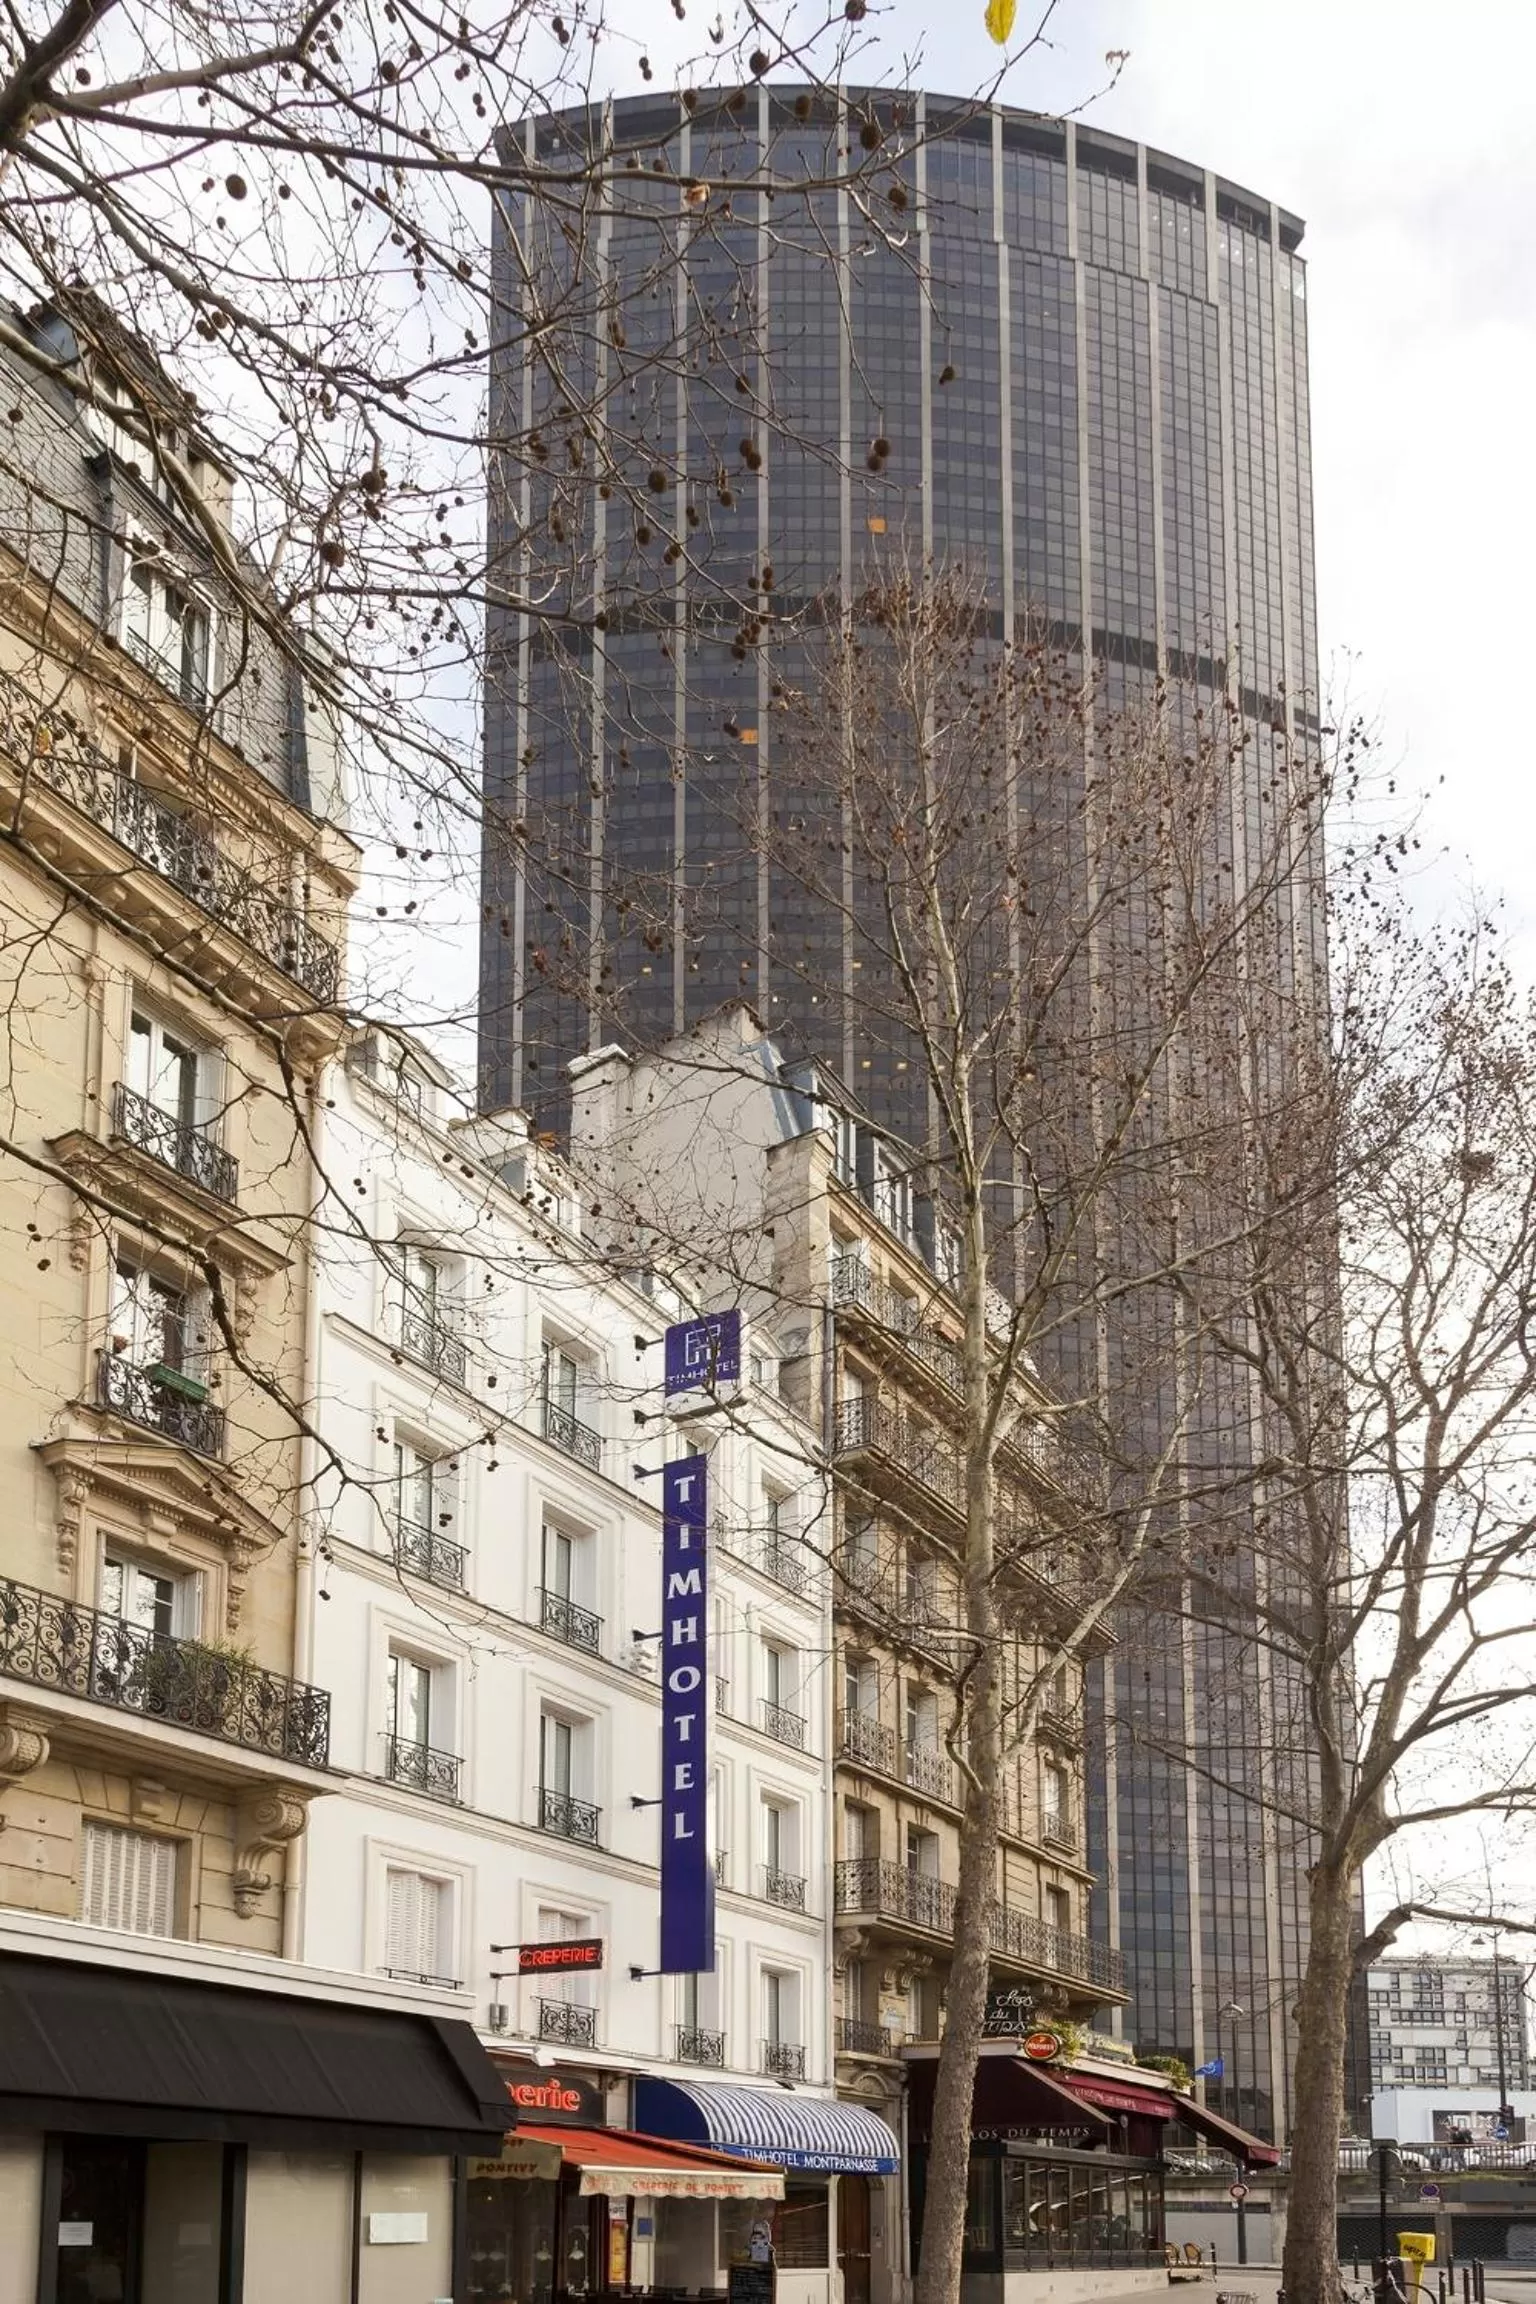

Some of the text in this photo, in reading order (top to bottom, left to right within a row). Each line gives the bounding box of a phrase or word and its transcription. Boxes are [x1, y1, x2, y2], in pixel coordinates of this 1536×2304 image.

[667, 1475, 702, 1840] TIMHOTEL
[518, 1946, 597, 1966] CREPERIE
[1008, 2128, 1031, 2138] DU
[1039, 2127, 1090, 2138] TEMPS
[742, 2148, 879, 2172] TIMHOTEL MONTPARNASSE
